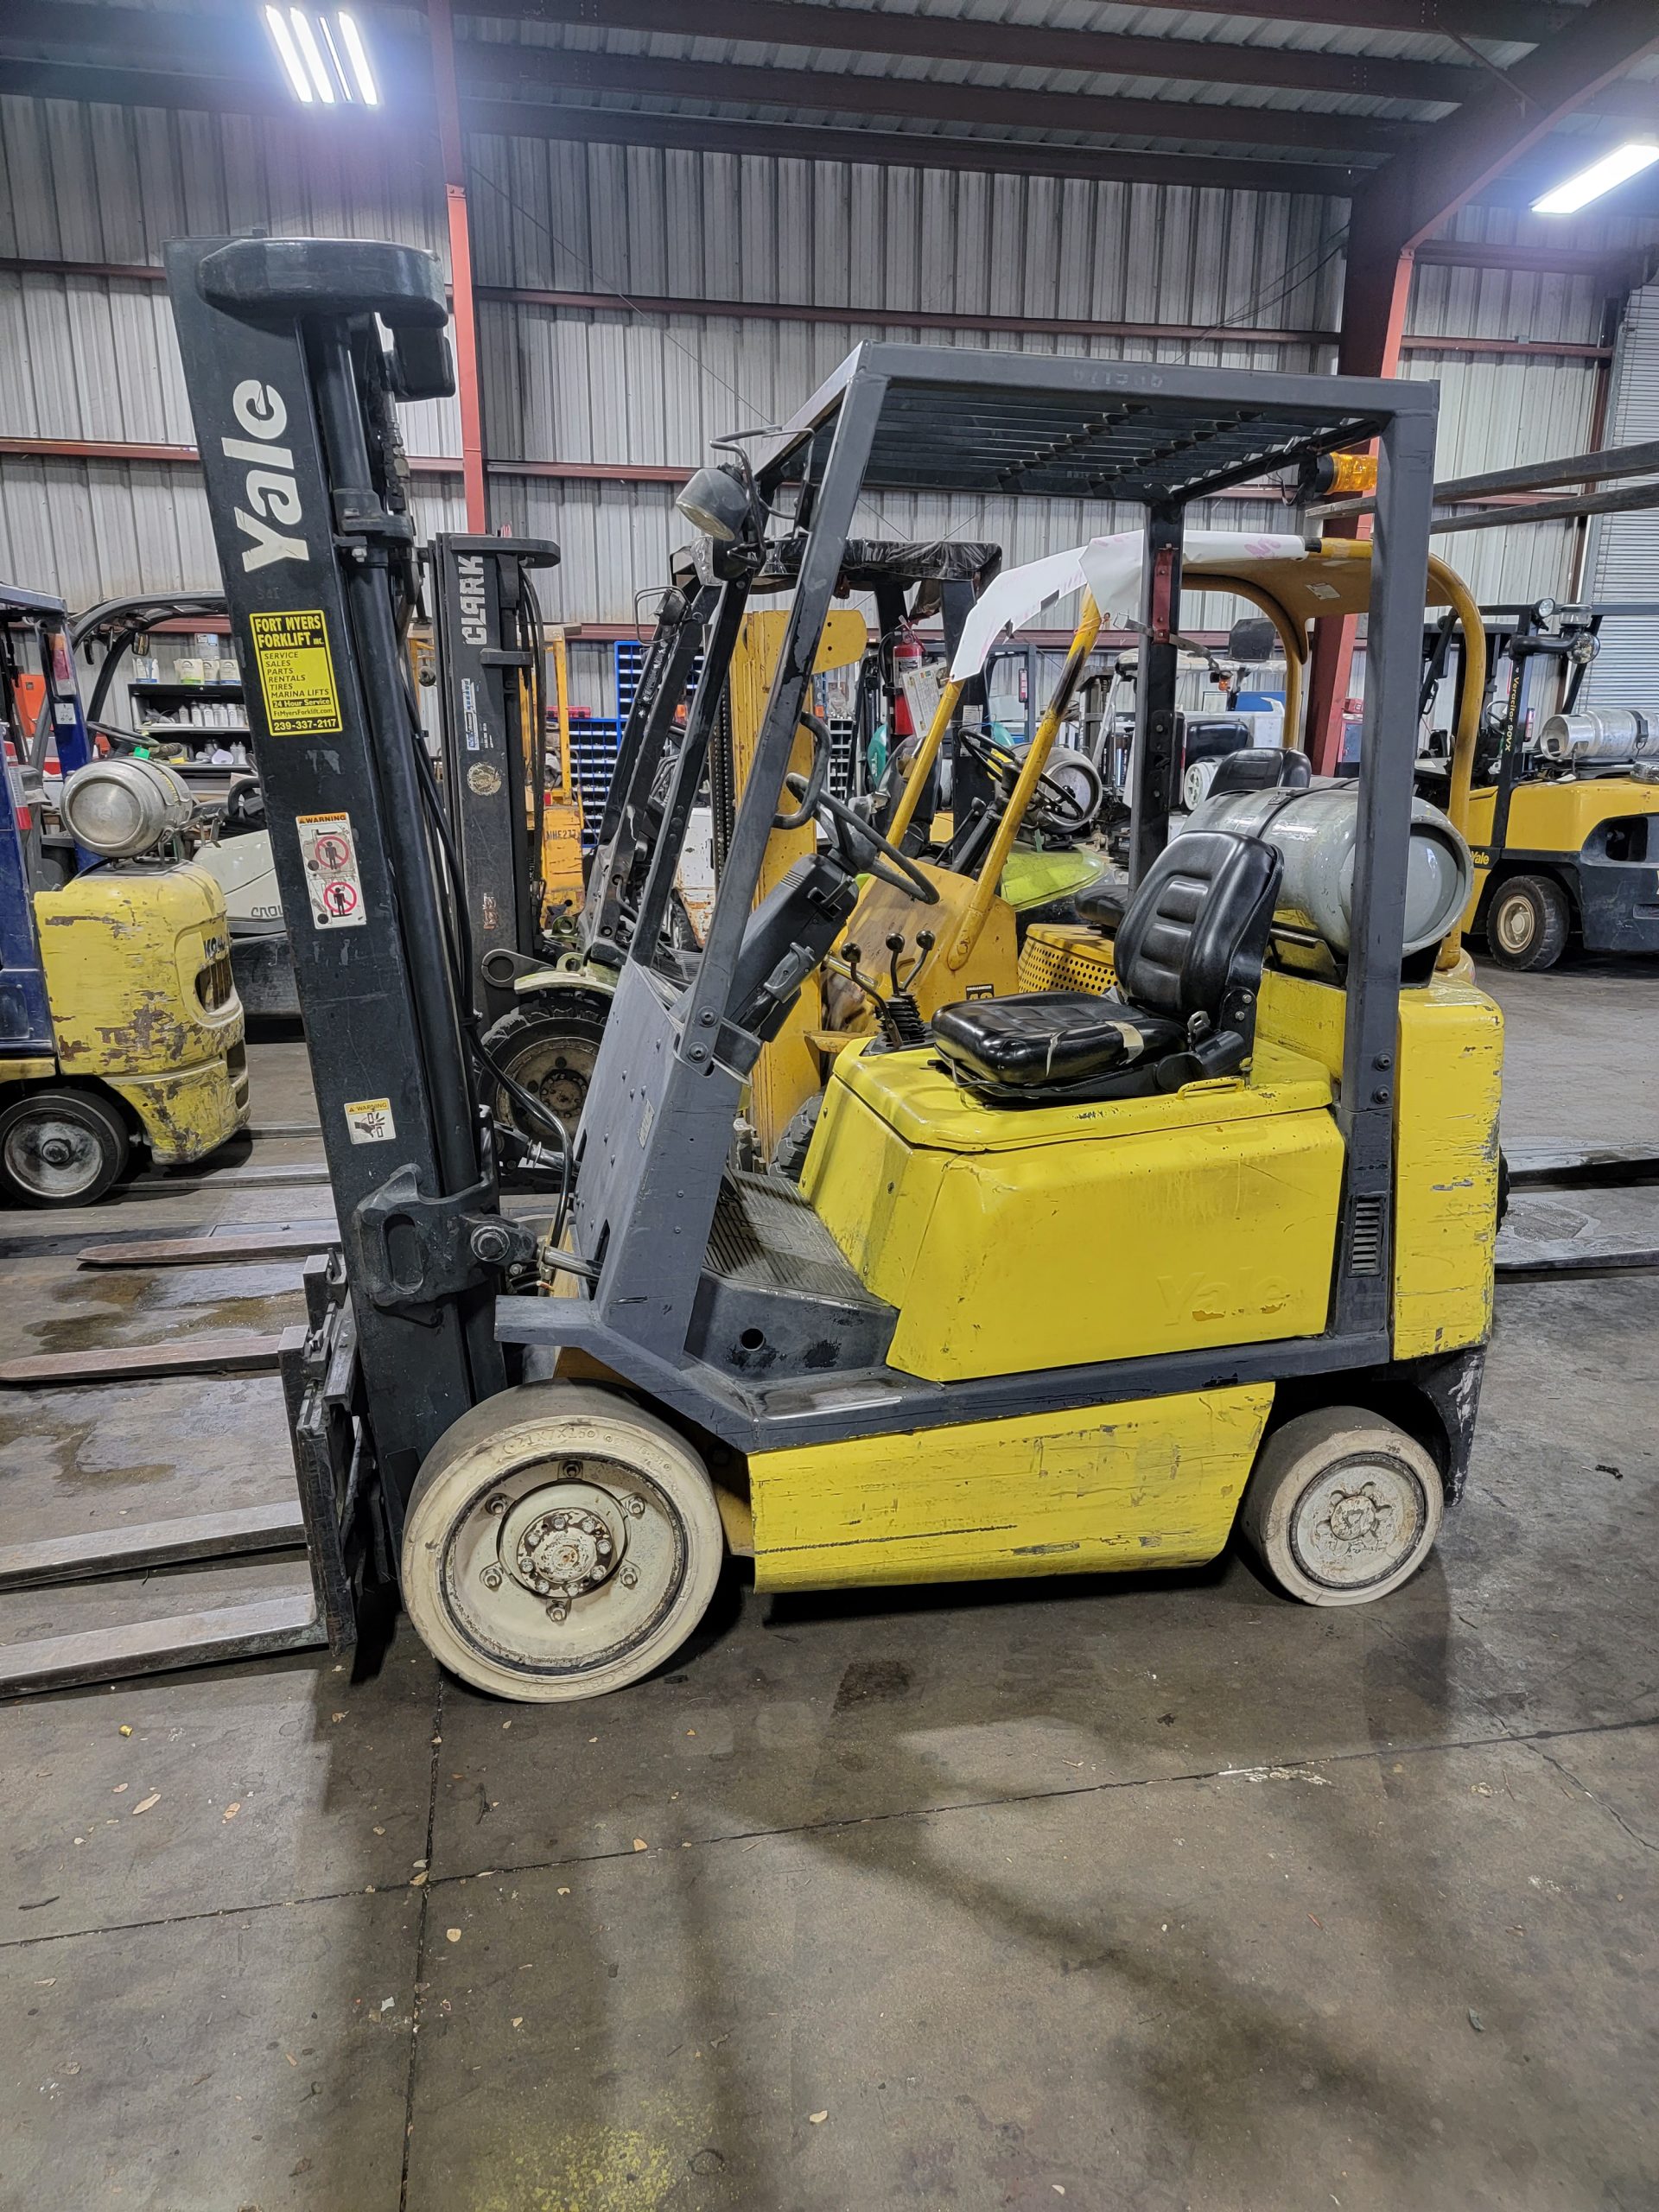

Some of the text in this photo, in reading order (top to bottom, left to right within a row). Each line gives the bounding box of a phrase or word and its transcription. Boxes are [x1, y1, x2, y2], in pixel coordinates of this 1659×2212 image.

[221, 379, 309, 573] Yale
[458, 555, 486, 645] CLARK
[255, 615, 321, 632] FORT MYERS
[257, 632, 311, 648] FORKLIFT
[270, 690, 305, 698] MARINA
[274, 708, 333, 717] FtMyersForklift.com
[1504, 677, 1520, 752] Veracitor 90VX
[274, 719, 336, 731] 239-337-2117
[305, 815, 346, 823] WARNING
[1471, 850, 1490, 865] Yale
[356, 1102, 387, 1112] WARNING
[1156, 1266, 1290, 1326] Yale
